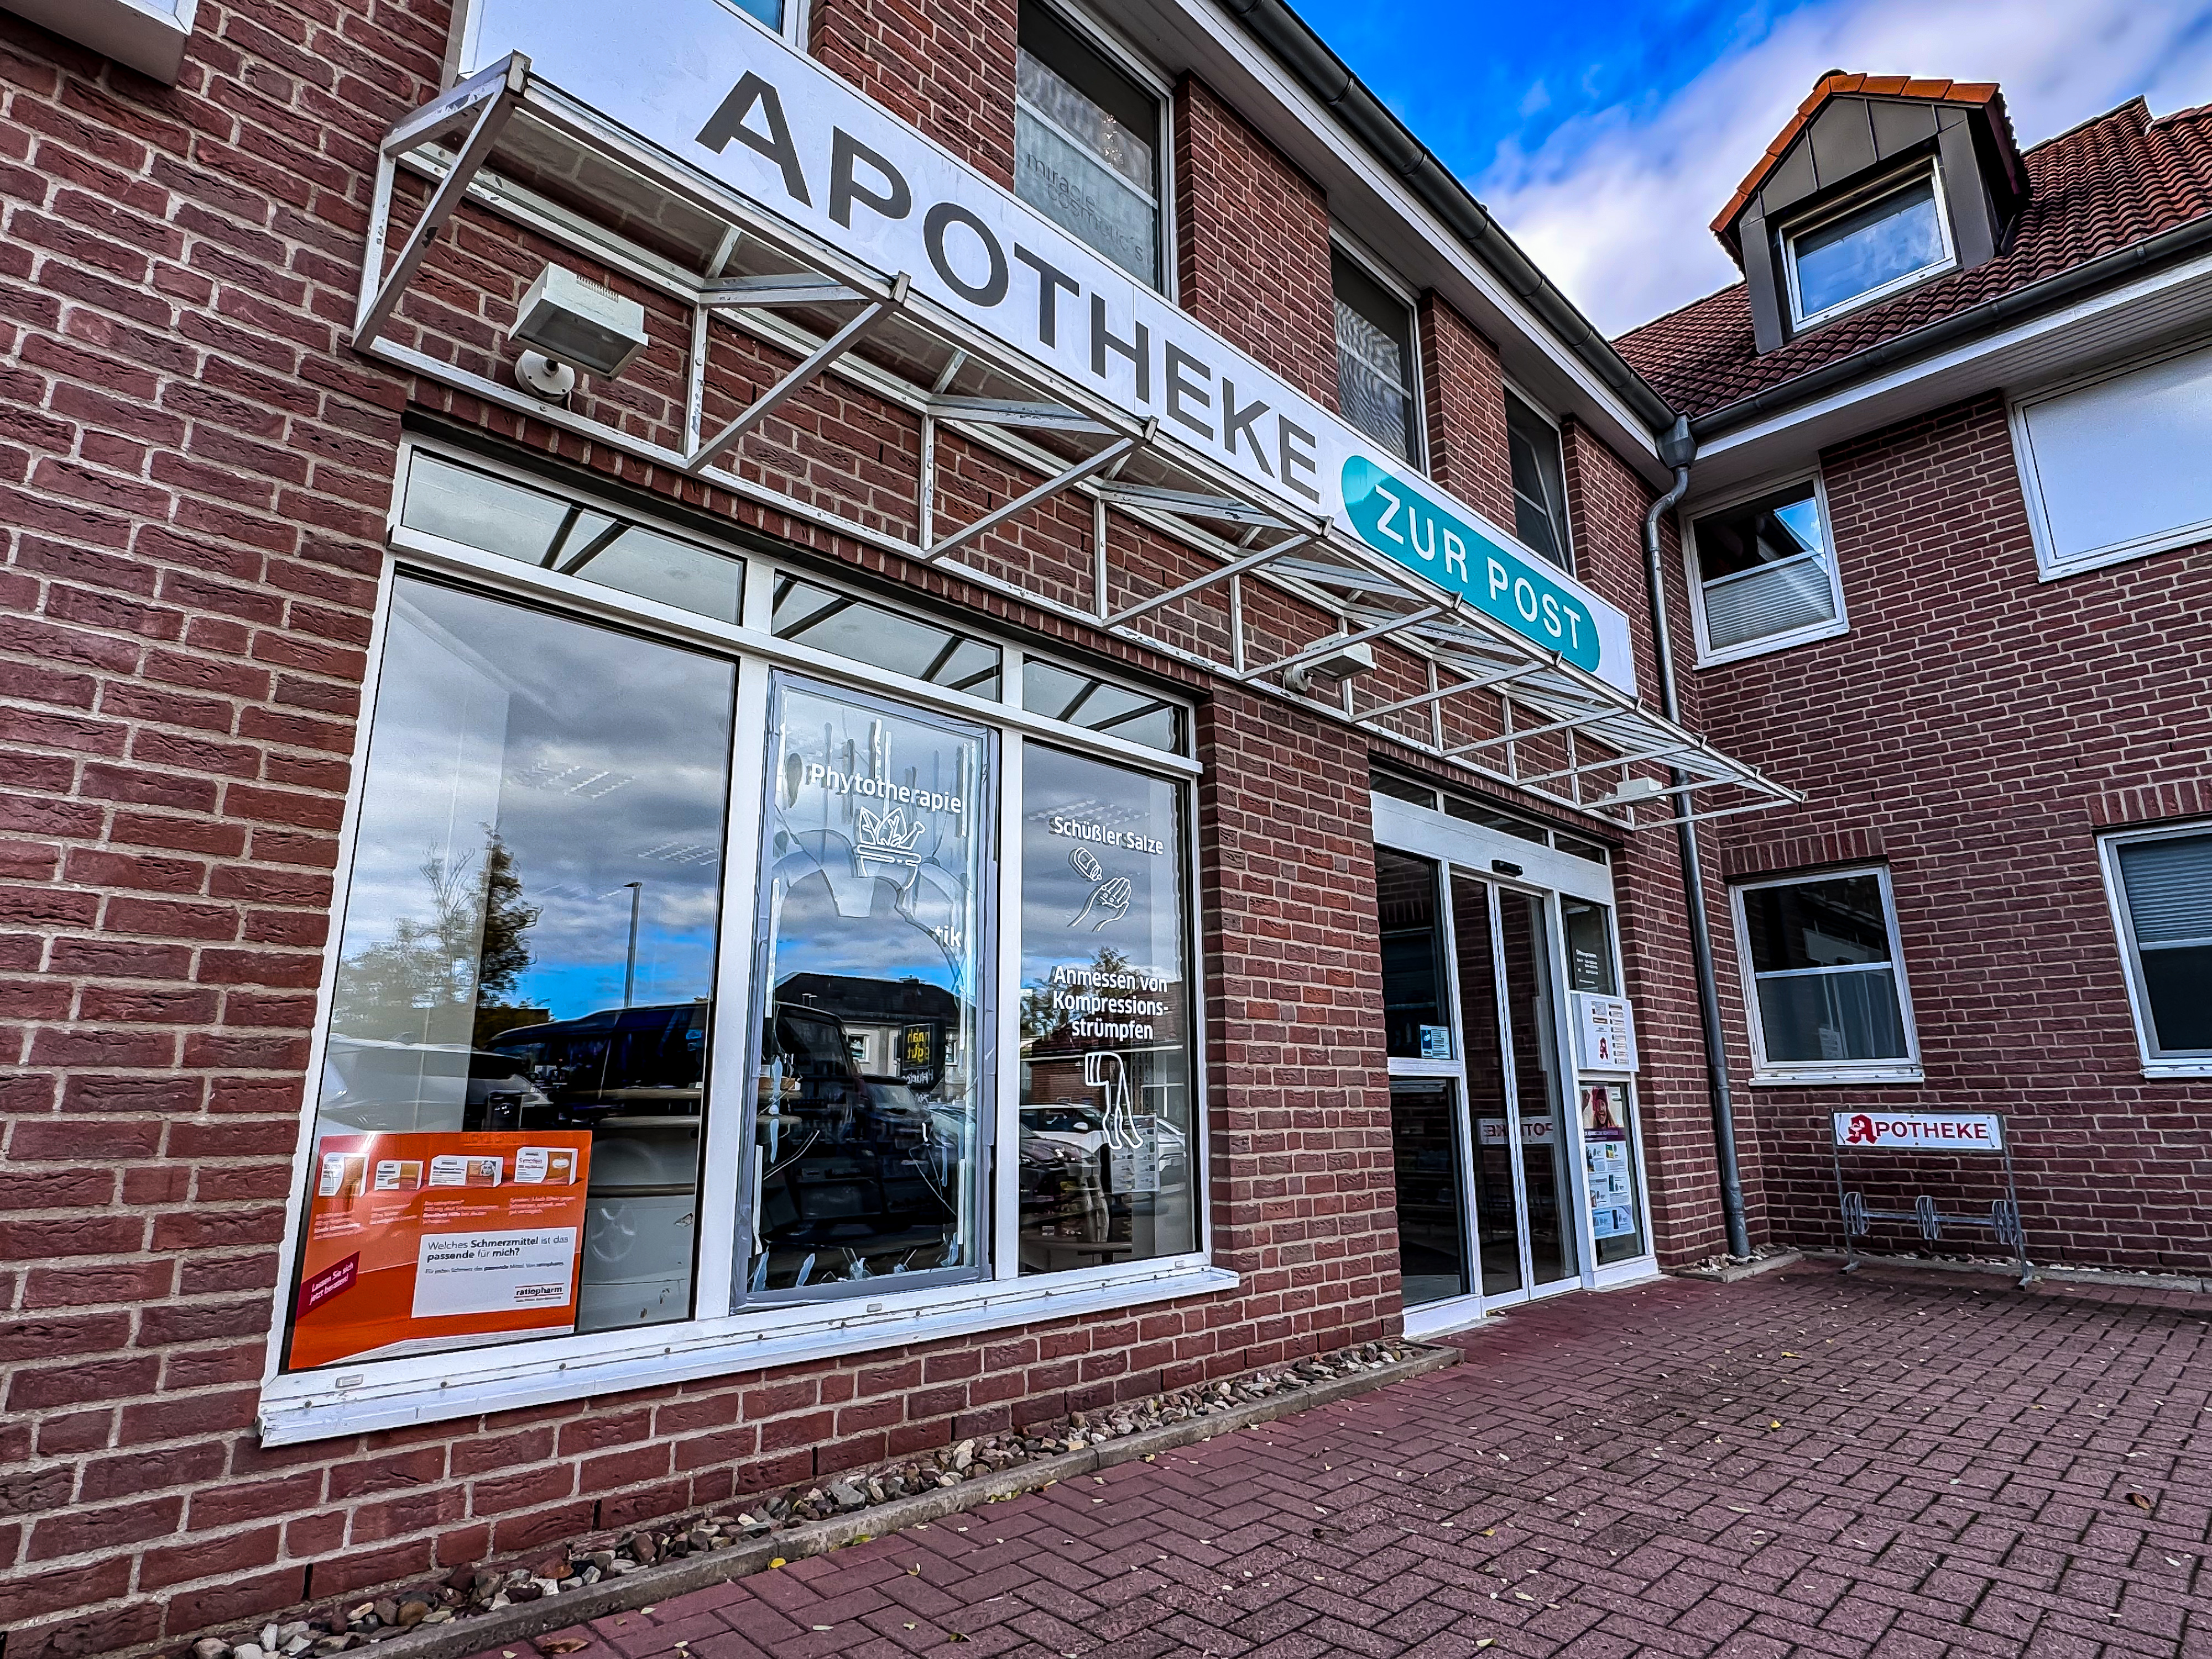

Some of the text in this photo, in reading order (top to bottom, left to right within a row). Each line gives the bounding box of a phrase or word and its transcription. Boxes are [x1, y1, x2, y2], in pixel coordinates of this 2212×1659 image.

[1027, 152, 1097, 212] miracle
[695, 70, 1321, 504] APOTHEKE
[1375, 484, 1582, 650] ZUR POST
[811, 763, 962, 813] Phytotherapie
[1054, 816, 1164, 855] Schüßler Salze
[1053, 966, 1168, 993] Anmessen von
[1053, 990, 1169, 1016] Kompressions-
[1072, 1017, 1154, 1042] strümpfen
[1845, 1113, 1990, 1145] APOTHEKE
[427, 1247, 520, 1263] passende für mich?
[428, 1240, 468, 1250] Welches
[470, 1236, 539, 1248] Schmerzmittel
[553, 1235, 568, 1243] das
[516, 1286, 563, 1296] ratiopharm
